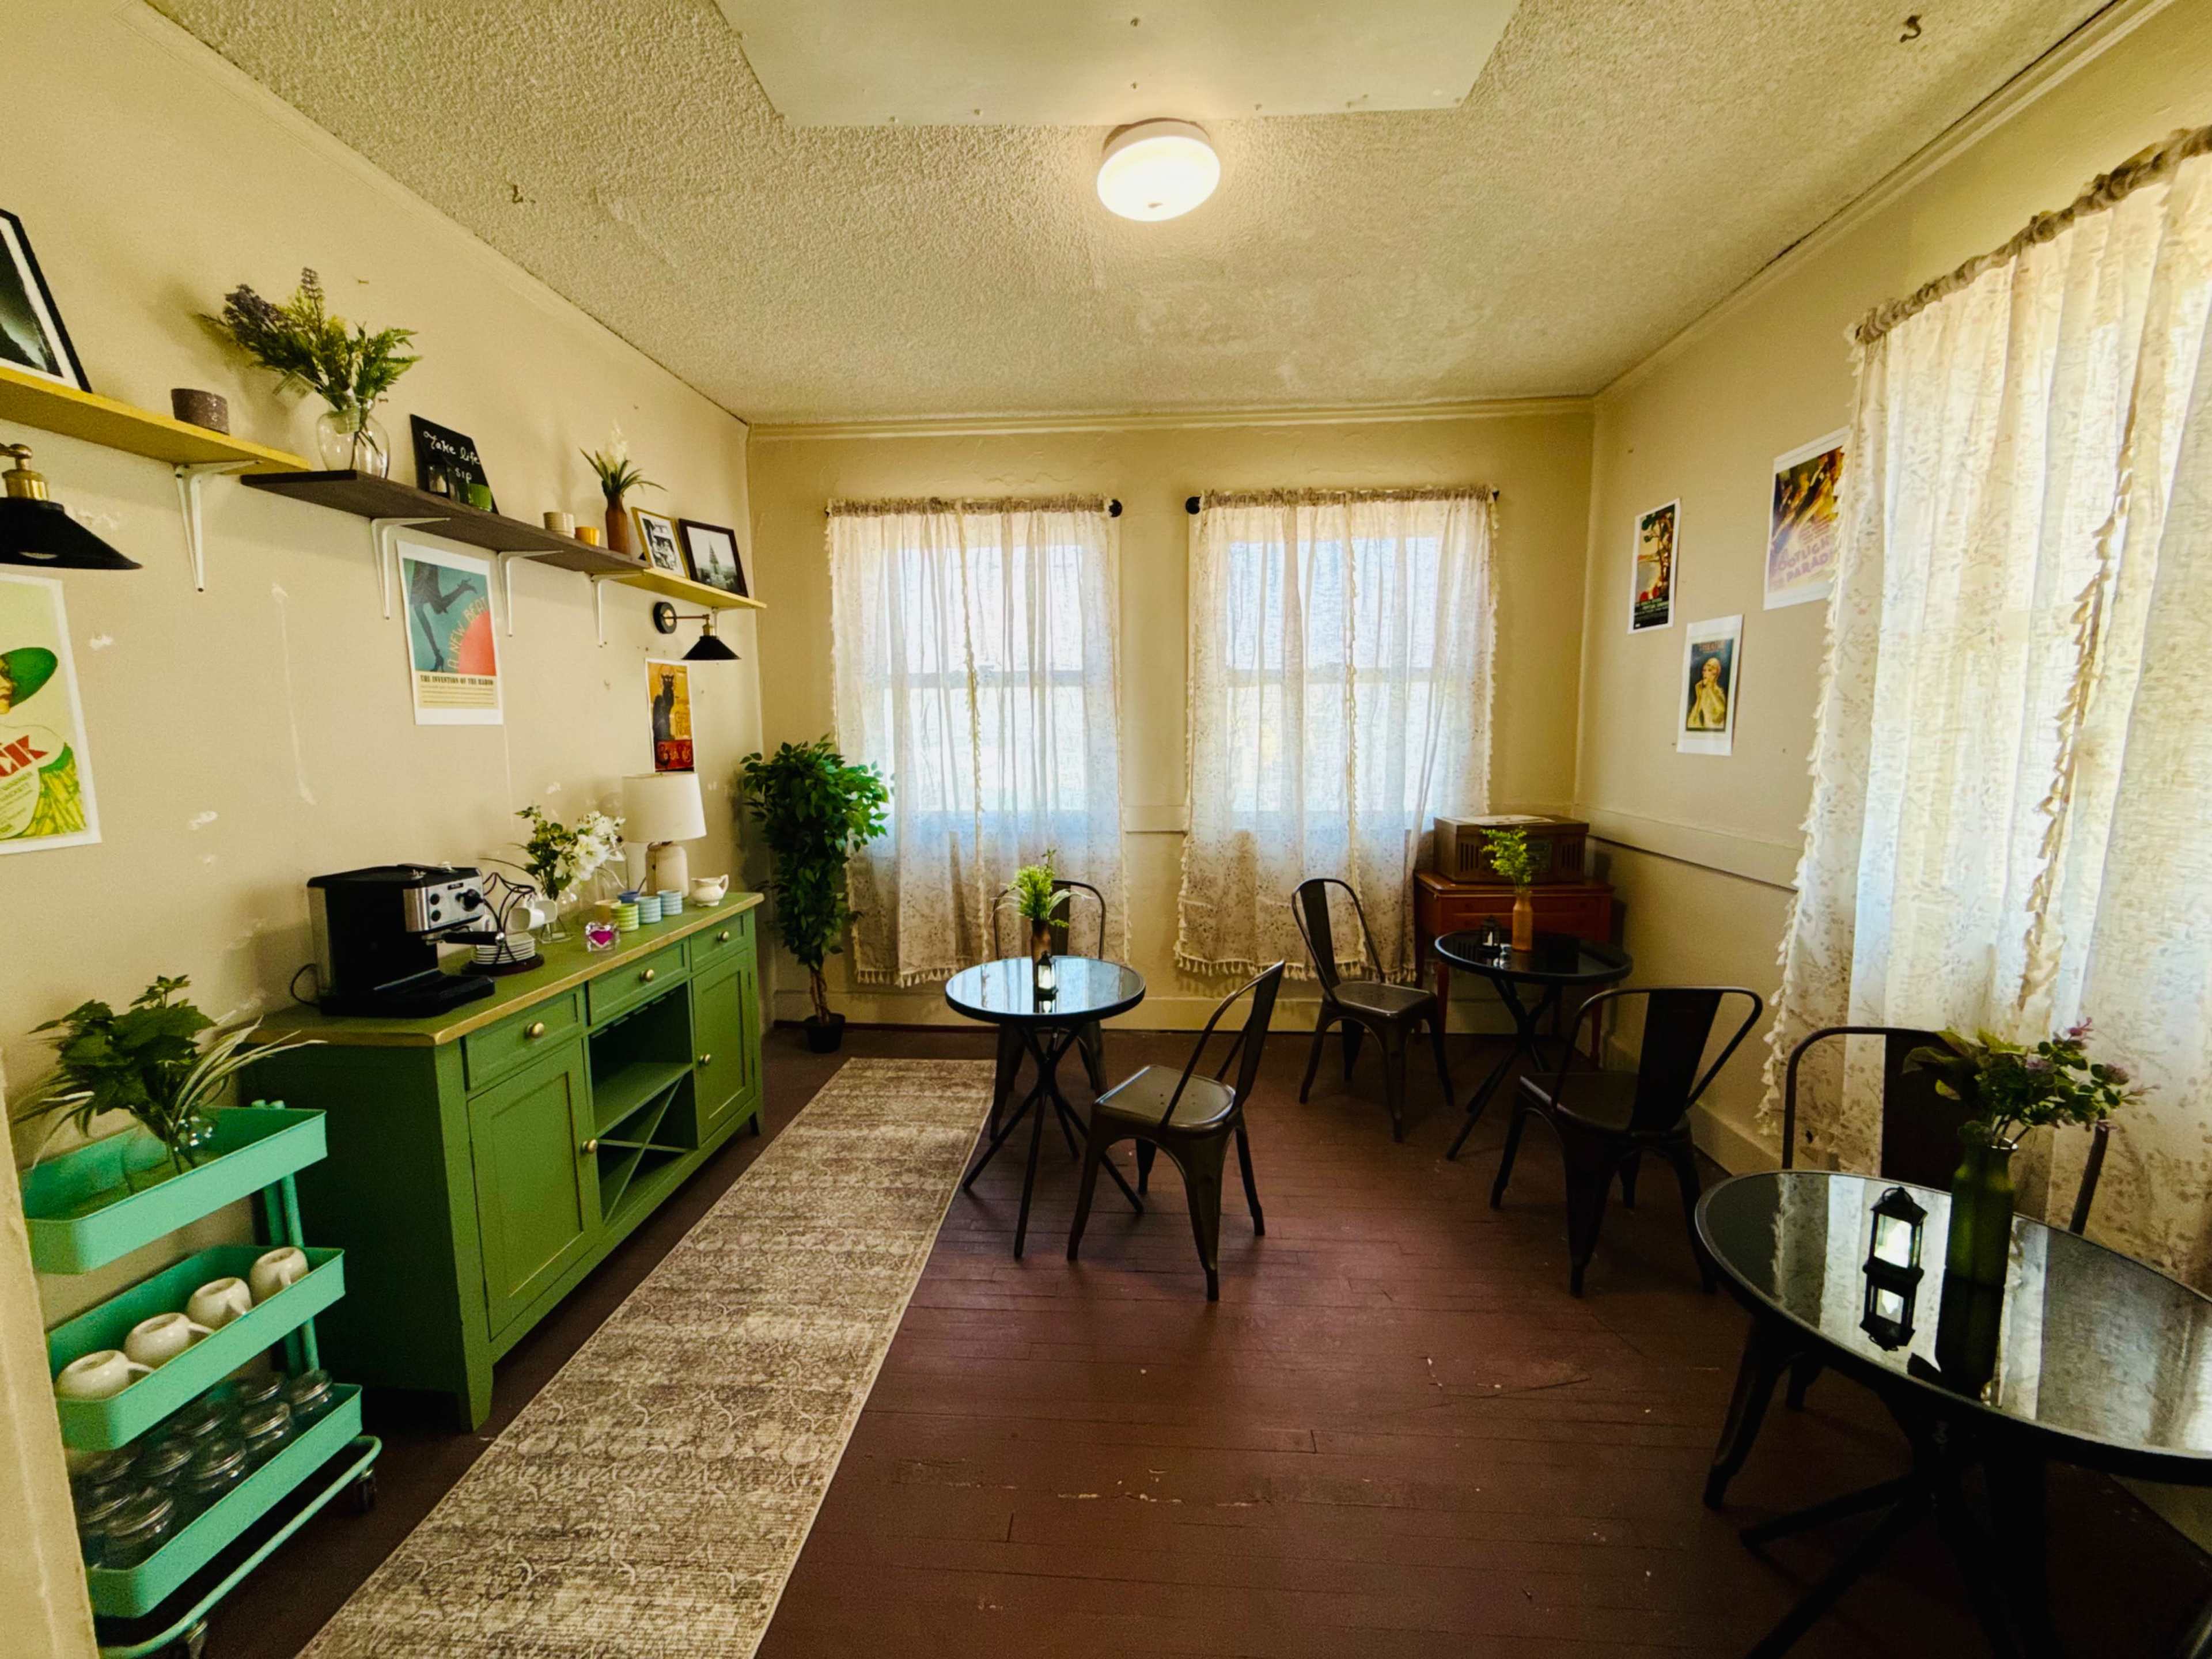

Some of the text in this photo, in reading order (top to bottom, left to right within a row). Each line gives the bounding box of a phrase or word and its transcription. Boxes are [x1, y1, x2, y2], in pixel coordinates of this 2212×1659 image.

[423, 430, 480, 465] Take life
[449, 620, 467, 654] NEW
[463, 596, 488, 623] BEAT
